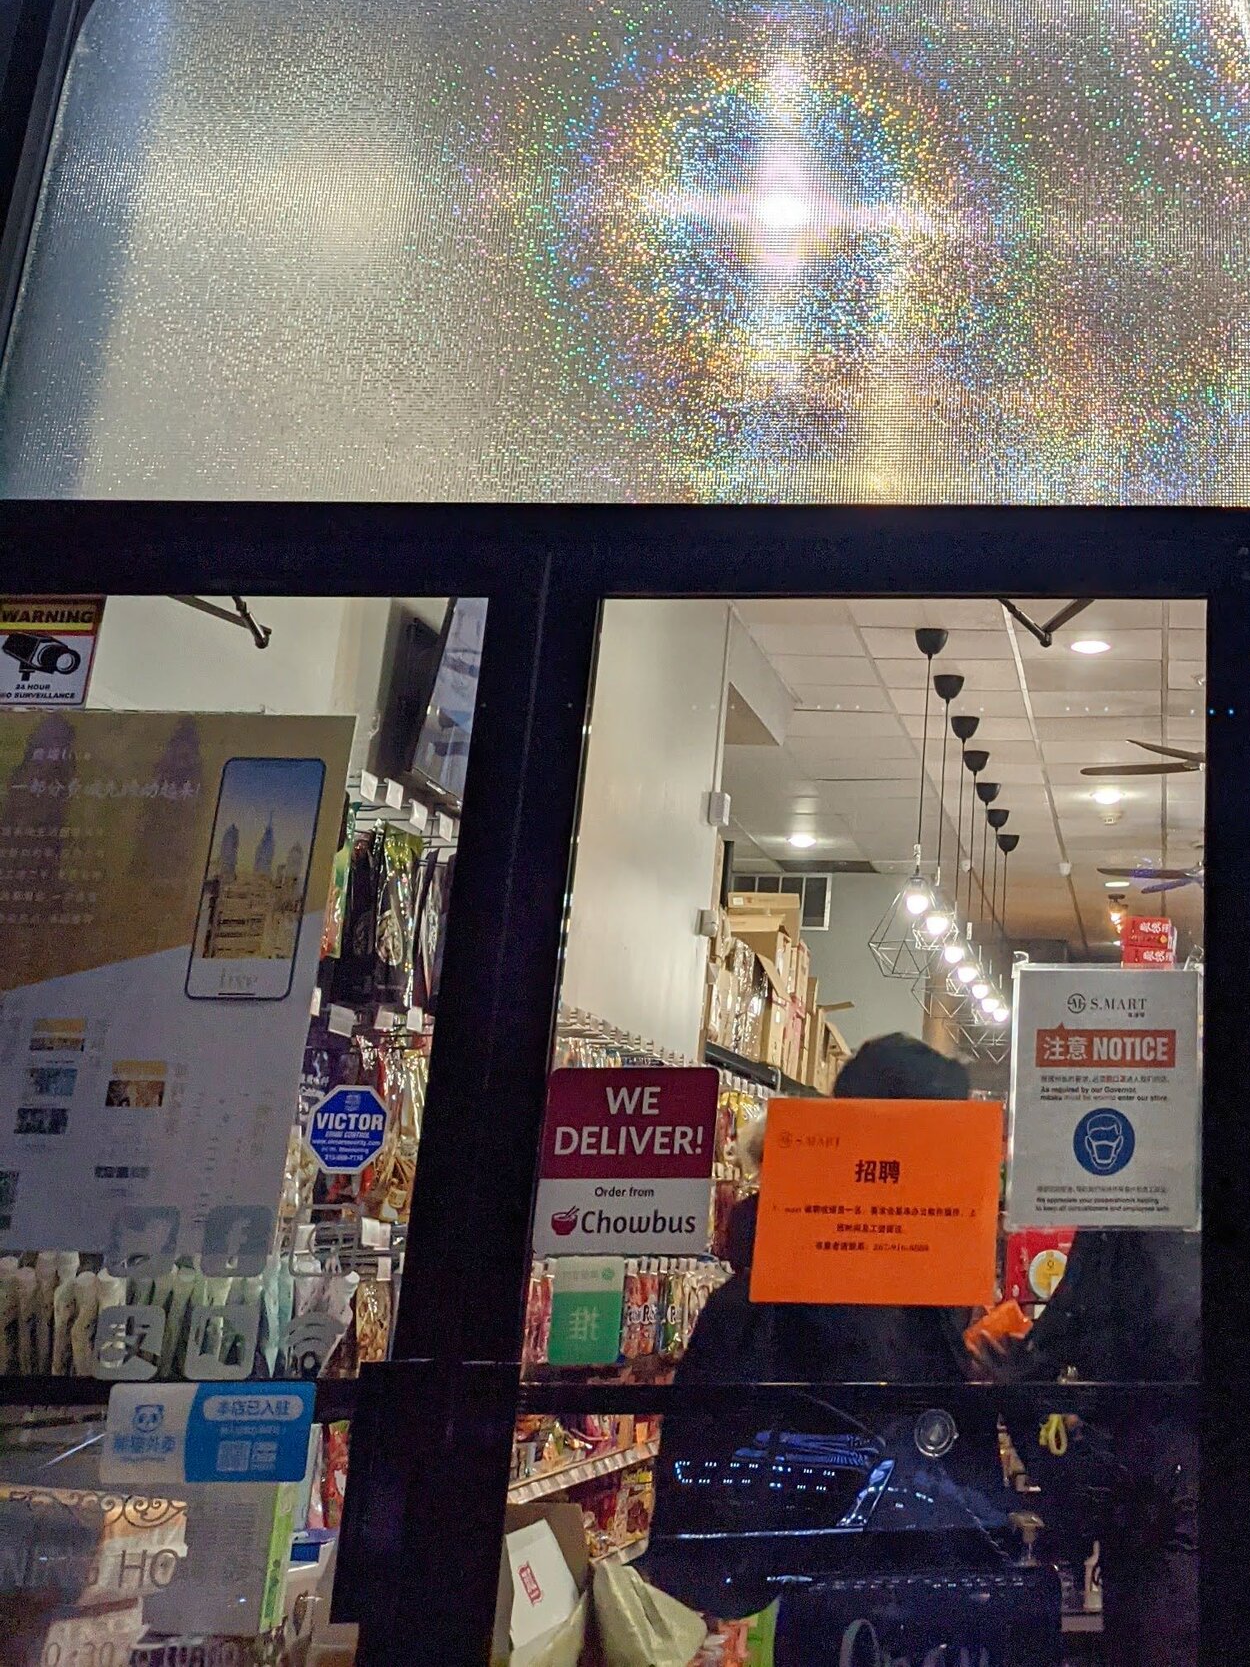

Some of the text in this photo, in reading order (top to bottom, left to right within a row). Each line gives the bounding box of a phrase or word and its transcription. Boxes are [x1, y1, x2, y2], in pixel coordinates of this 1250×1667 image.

[1, 610, 94, 623] WARNING
[1090, 998, 1147, 1011] S.MART
[1043, 1036, 1168, 1062] 注意 NOTICE
[1040, 1086, 1050, 1094] As
[1081, 1086, 1089, 1095] by
[606, 1086, 661, 1115] WE
[316, 1112, 384, 1131] VICTOR
[554, 1126, 704, 1155] DELIVER!
[854, 1159, 901, 1184] 招聘
[594, 1186, 655, 1197] Order from
[581, 1209, 696, 1233] Chowbus
[216, 1398, 291, 1417] 本店已入驻
